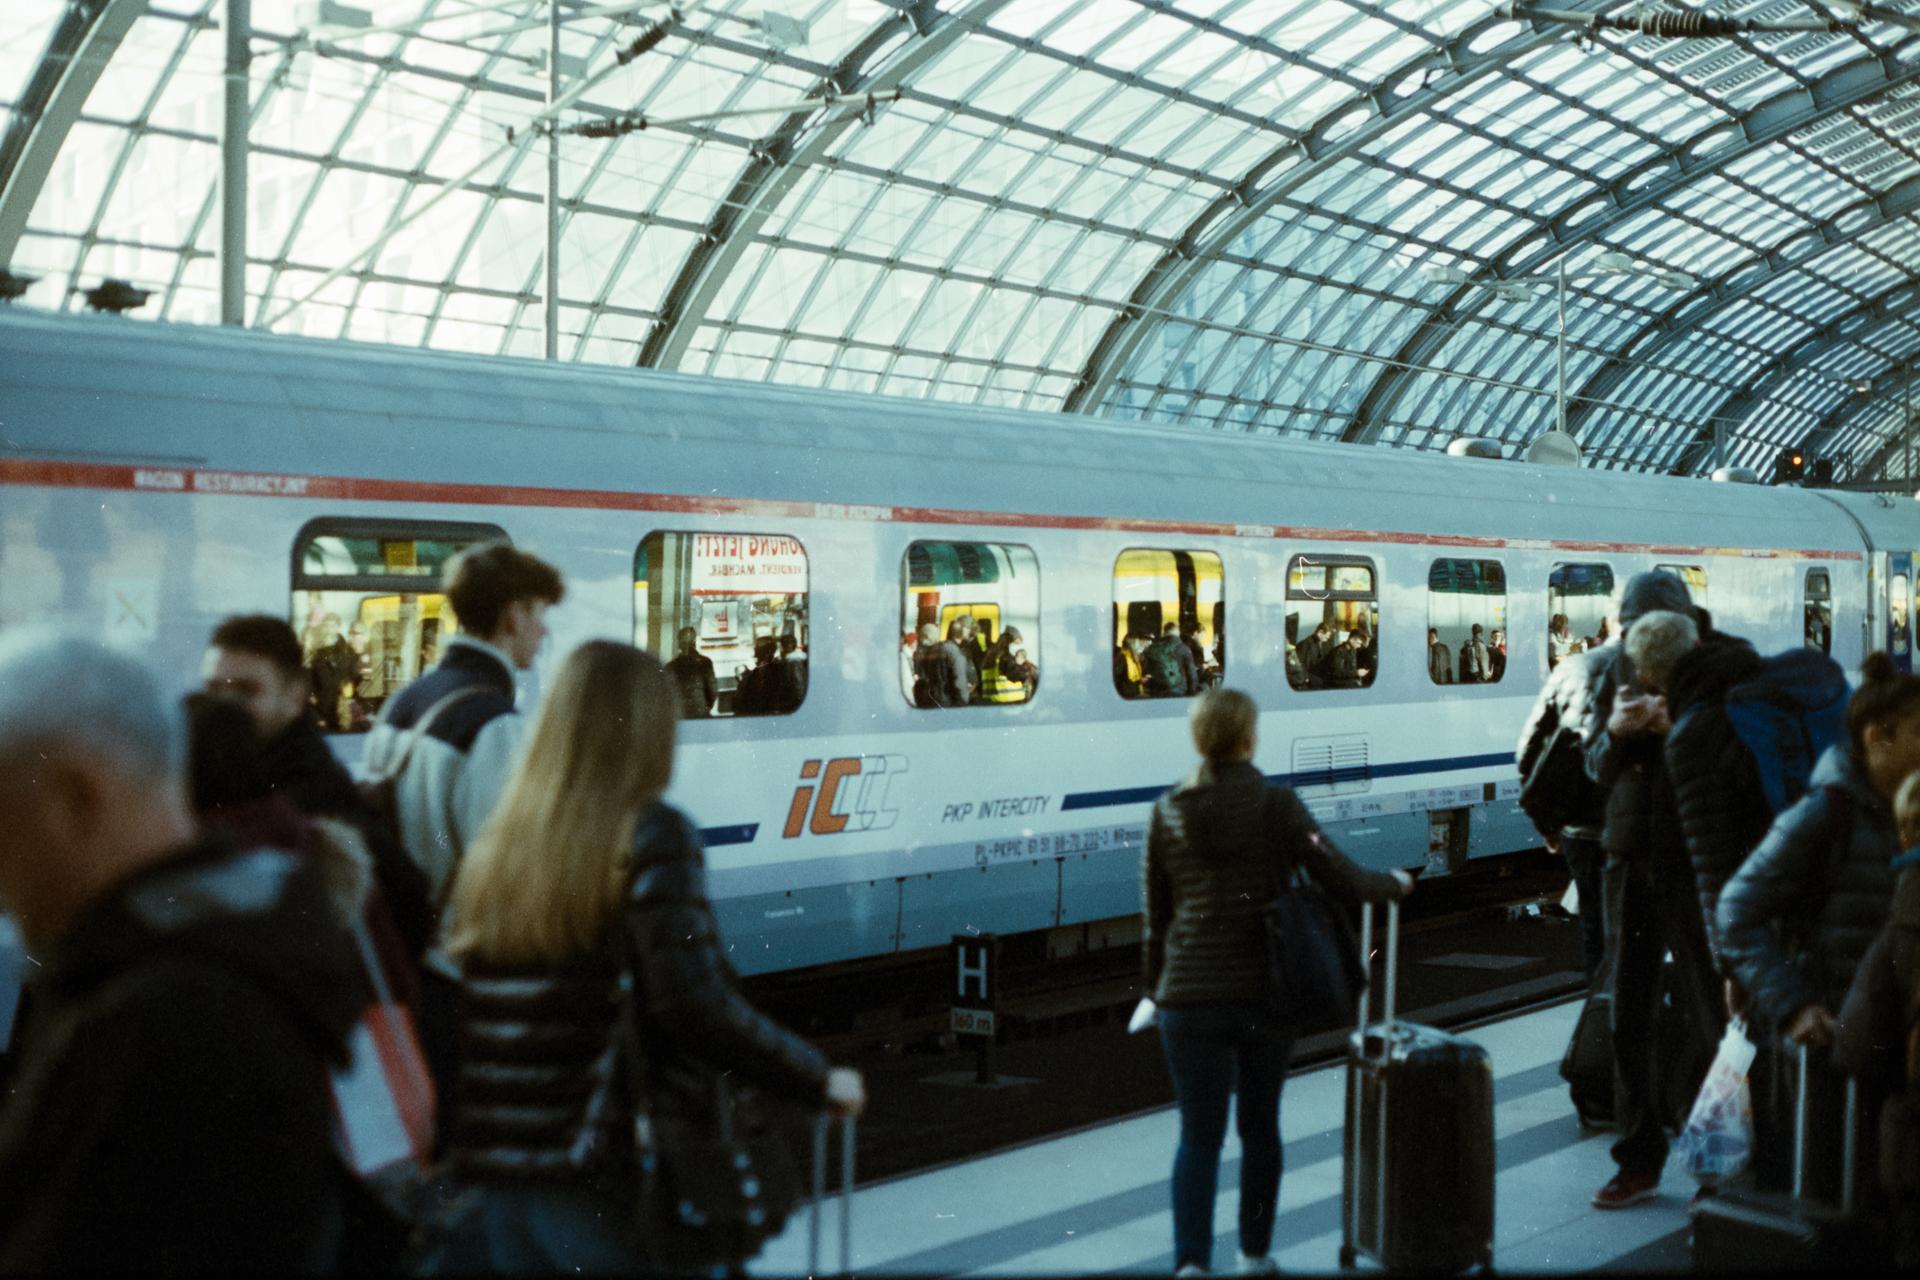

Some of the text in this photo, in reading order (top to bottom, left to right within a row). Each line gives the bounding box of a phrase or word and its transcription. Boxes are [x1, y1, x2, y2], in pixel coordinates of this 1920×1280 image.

[134, 470, 307, 494] WAGON RESTAURACYJNY
[941, 795, 1051, 823] PKP INTERCITY
[959, 945, 987, 999] H
